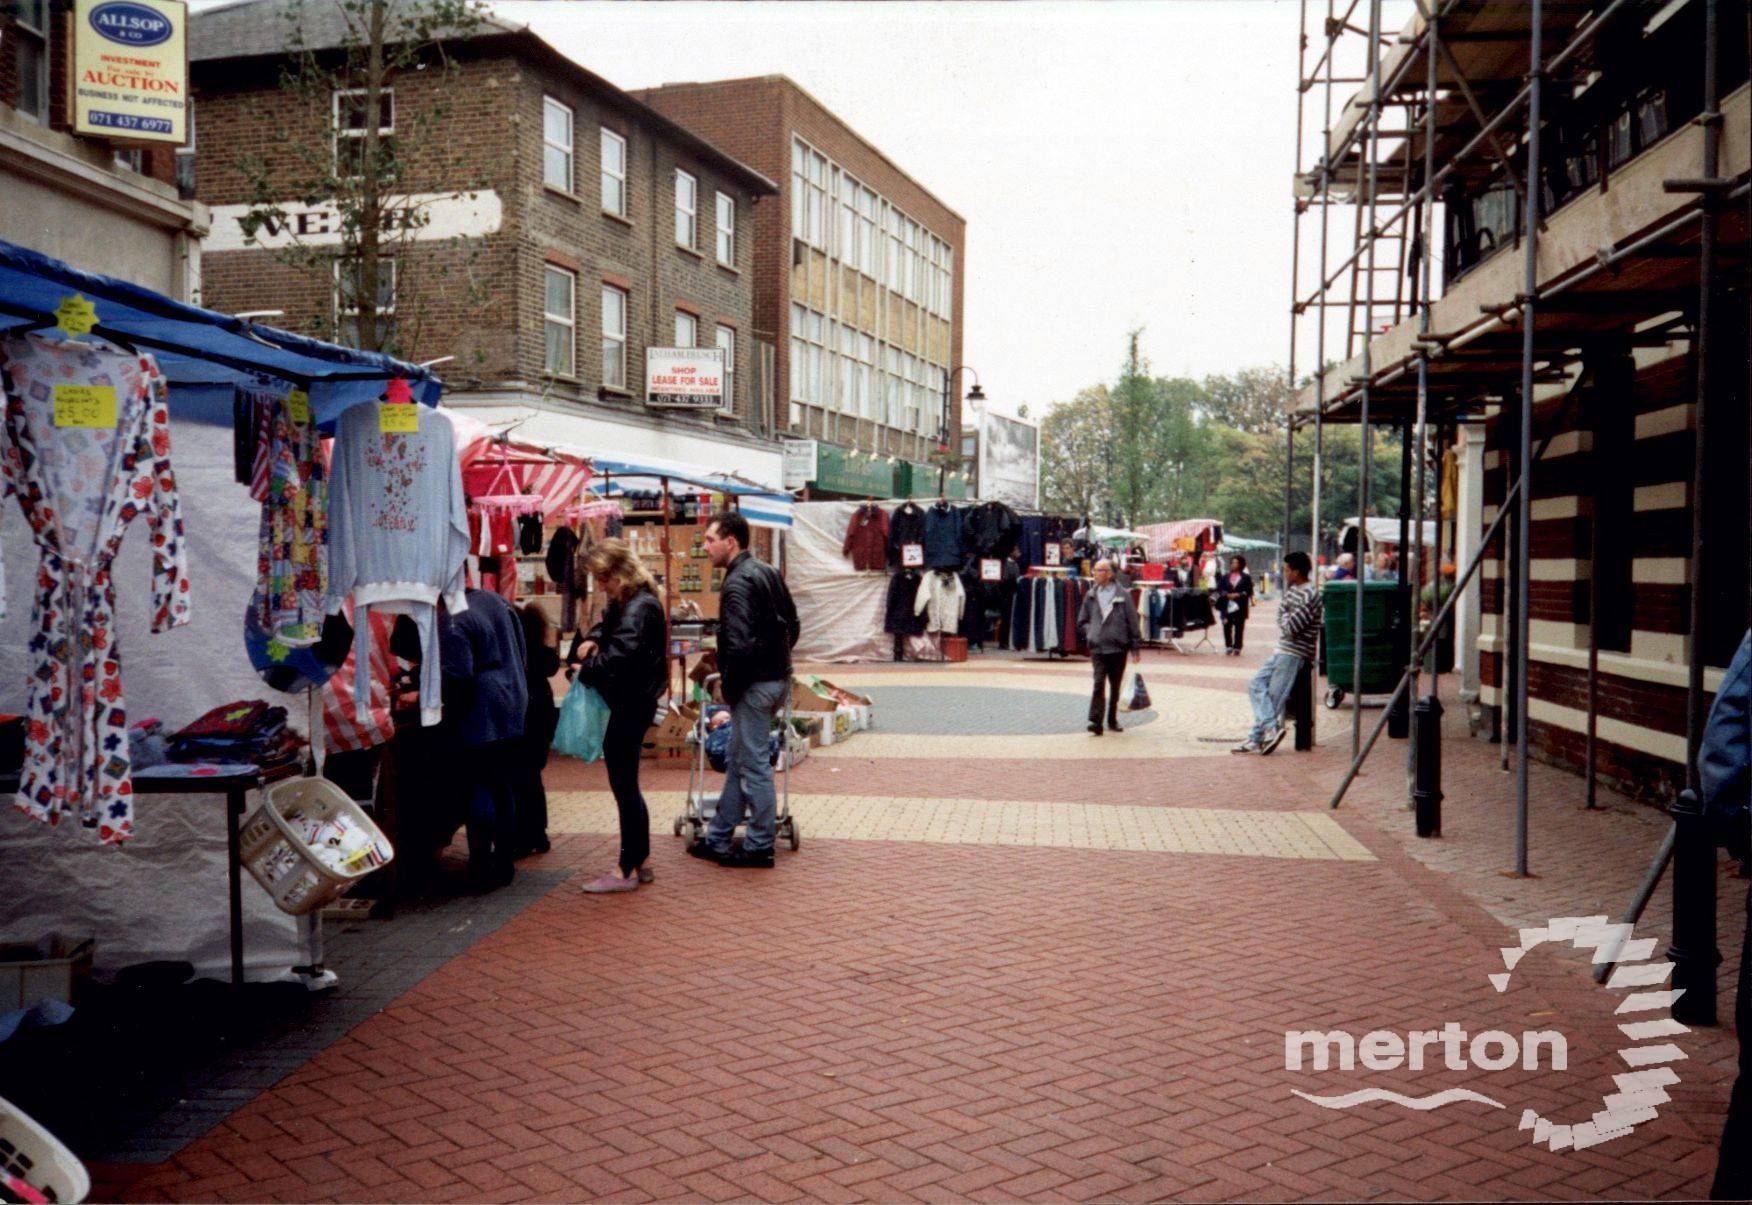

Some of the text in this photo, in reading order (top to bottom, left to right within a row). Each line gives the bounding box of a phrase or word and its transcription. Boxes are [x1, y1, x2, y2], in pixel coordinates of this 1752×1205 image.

[99, 14, 164, 31] ALLSOP
[101, 54, 160, 67] INVESTMENT
[83, 69, 179, 93] AUCTION
[78, 88, 184, 109] BUSINESS NOT AFFECTED
[90, 112, 112, 123] 071
[141, 119, 171, 131] 6977
[652, 375, 718, 386] LEASE FOR SALE
